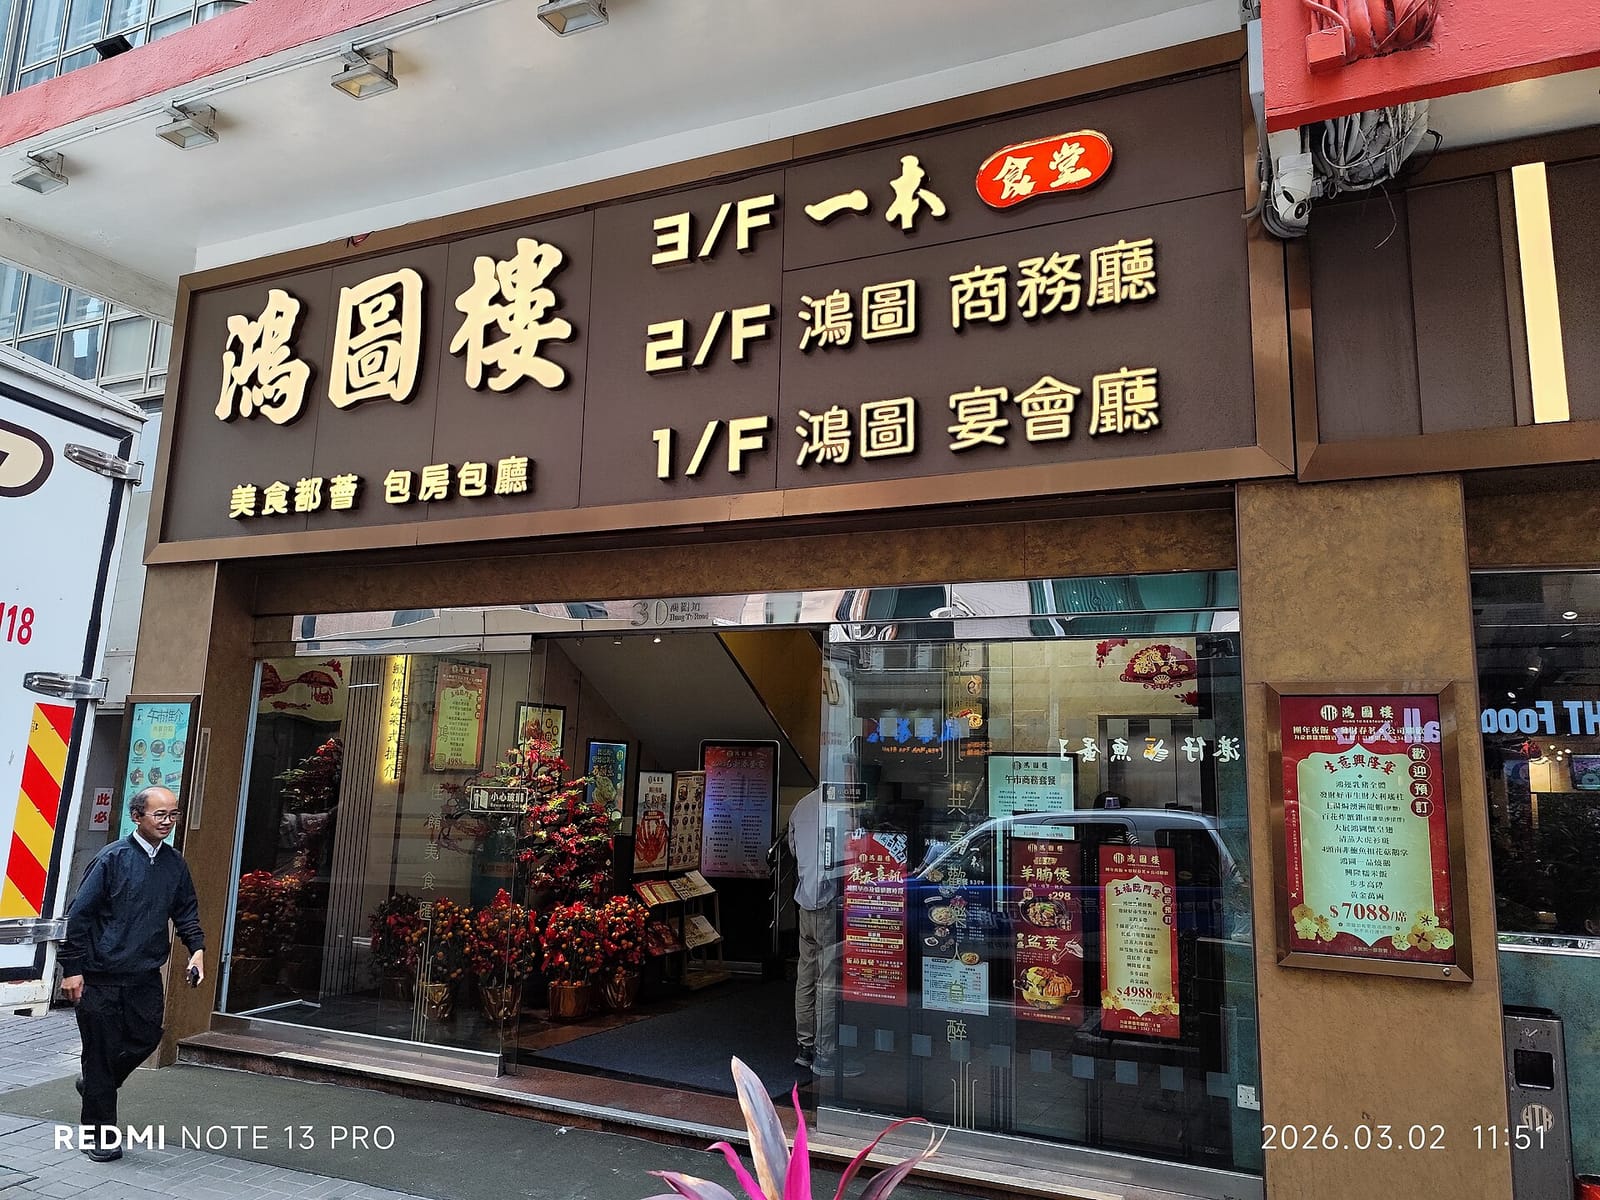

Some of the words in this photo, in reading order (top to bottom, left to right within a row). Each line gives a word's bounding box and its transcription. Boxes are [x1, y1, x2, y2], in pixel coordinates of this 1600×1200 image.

[996, 142, 1091, 200] 食堂
[652, 193, 777, 266] 3/F
[645, 303, 771, 373] 2/F
[798, 279, 916, 351] 鴻圖
[949, 238, 1157, 328] 商務廳
[214, 237, 572, 425] 鴻圖樓
[652, 415, 769, 479] 1/F
[795, 397, 915, 467] 鴻圖
[948, 366, 1160, 451] 宴會廳
[229, 473, 360, 520] 美食都薈
[383, 455, 530, 504] 包房包廳
[631, 599, 669, 627] 30
[1341, 705, 1394, 719] 鴻圖樓
[1324, 754, 1397, 775] 生意興隆宴
[1005, 775, 1056, 785] 午市商務套餐
[1411, 747, 1430, 814] 歡迎預訂
[1127, 853, 1160, 866] 鴻圖樓
[1020, 865, 1072, 885] 羊腩煲
[1048, 891, 1071, 901] $298
[1114, 883, 1161, 900] 五福臨門宴
